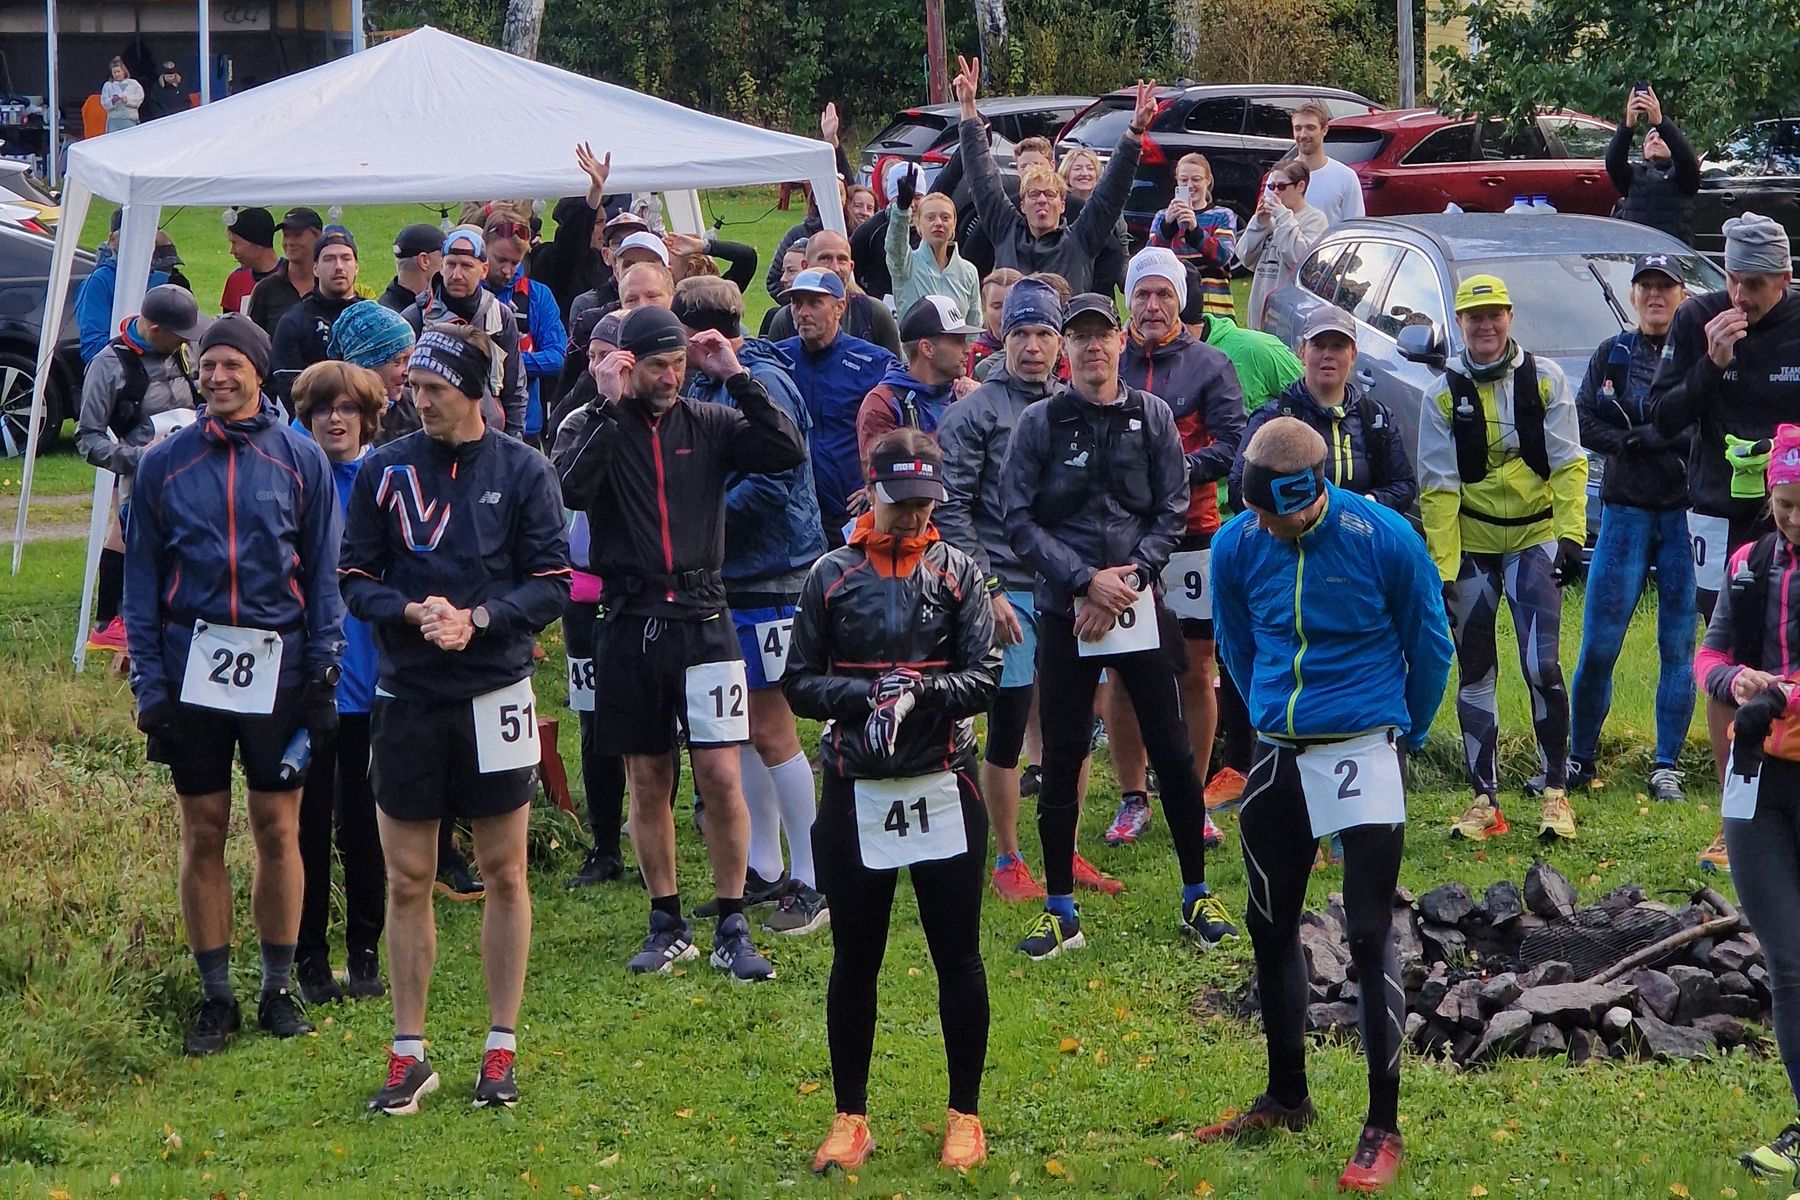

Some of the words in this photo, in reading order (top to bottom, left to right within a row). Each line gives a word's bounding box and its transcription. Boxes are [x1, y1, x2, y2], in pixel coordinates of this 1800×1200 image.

[1184, 571, 1202, 600] 9
[208, 648, 256, 688] 28
[571, 661, 596, 691] 48
[709, 683, 744, 718] 12
[499, 702, 533, 743] 51
[1333, 759, 1361, 800] 2
[884, 796, 930, 838] 41
